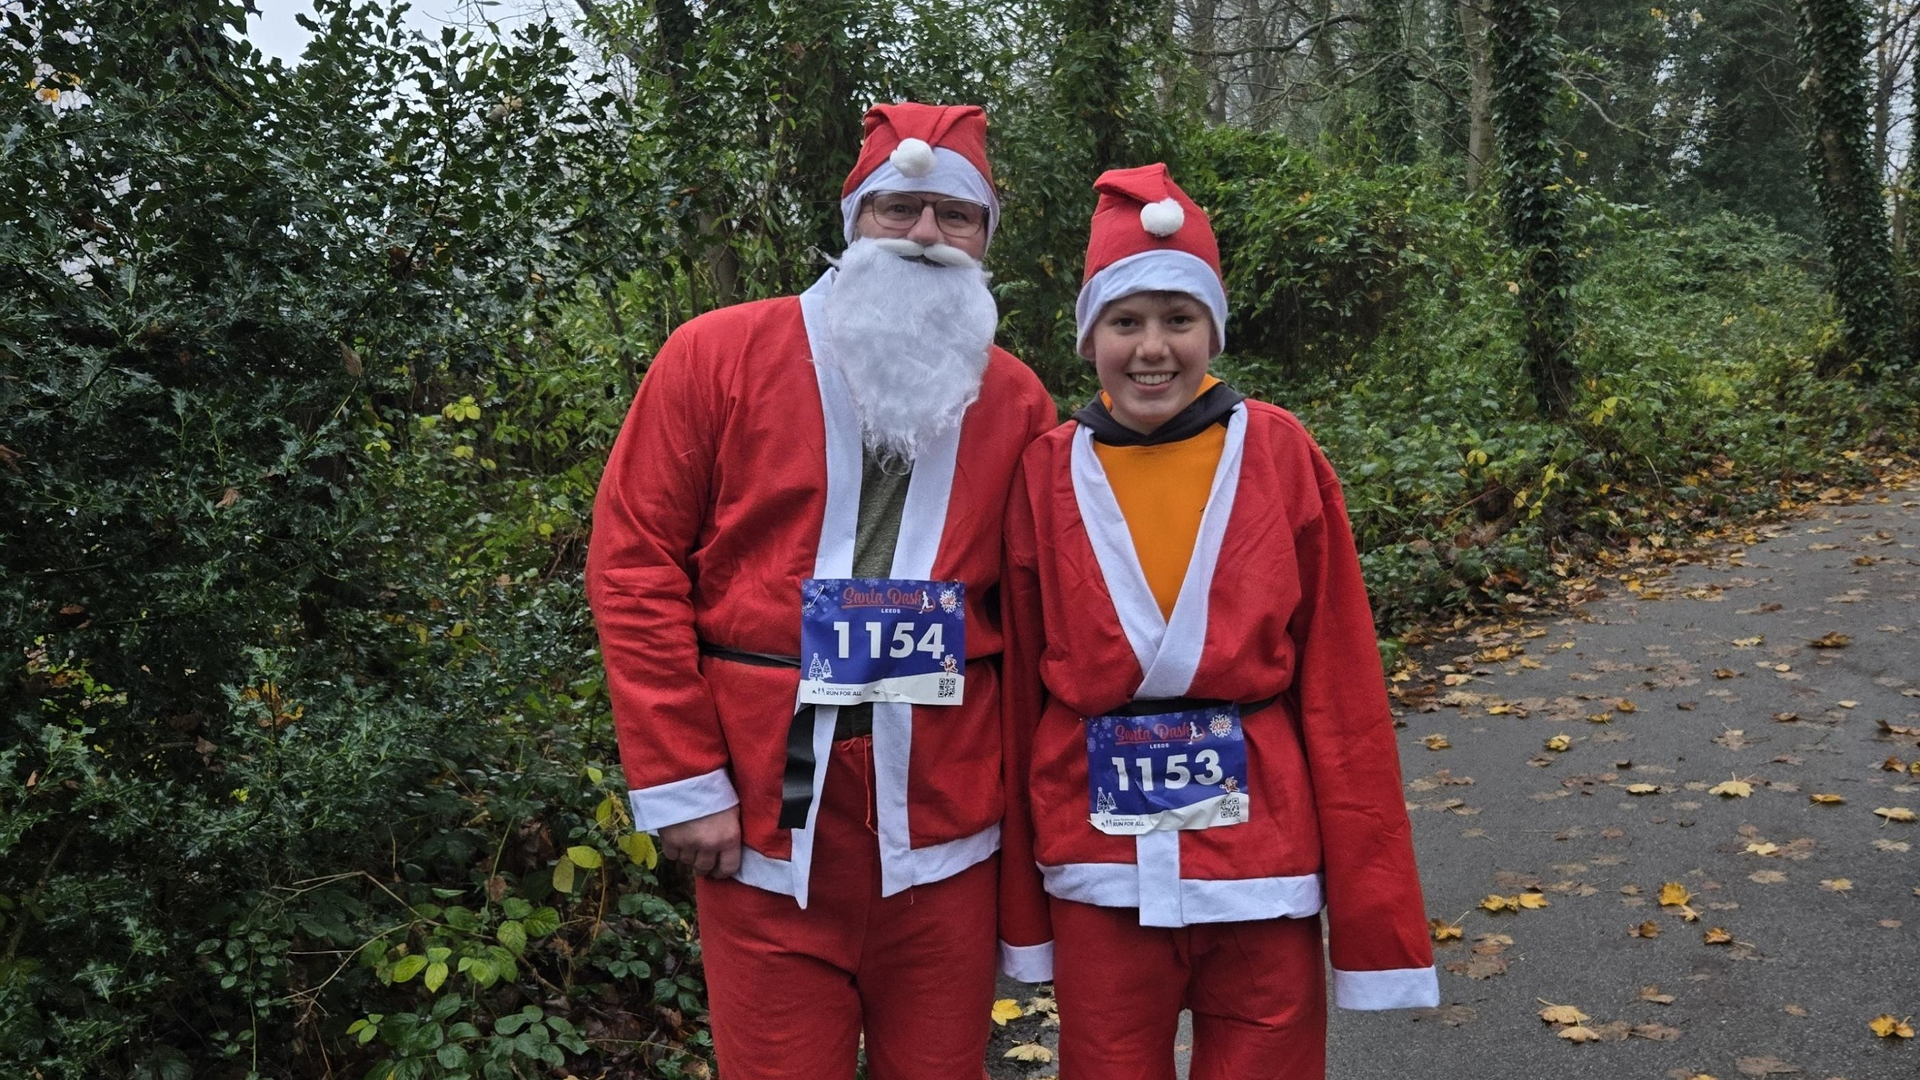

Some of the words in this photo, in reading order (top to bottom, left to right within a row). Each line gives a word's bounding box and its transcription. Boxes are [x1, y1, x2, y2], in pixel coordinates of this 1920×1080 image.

[844, 587, 885, 605] Santa
[887, 587, 922, 606] Dash
[833, 621, 945, 660] 1154
[1115, 724, 1152, 741] Santa
[1153, 722, 1190, 740] Dash
[1111, 749, 1223, 792] 1153
